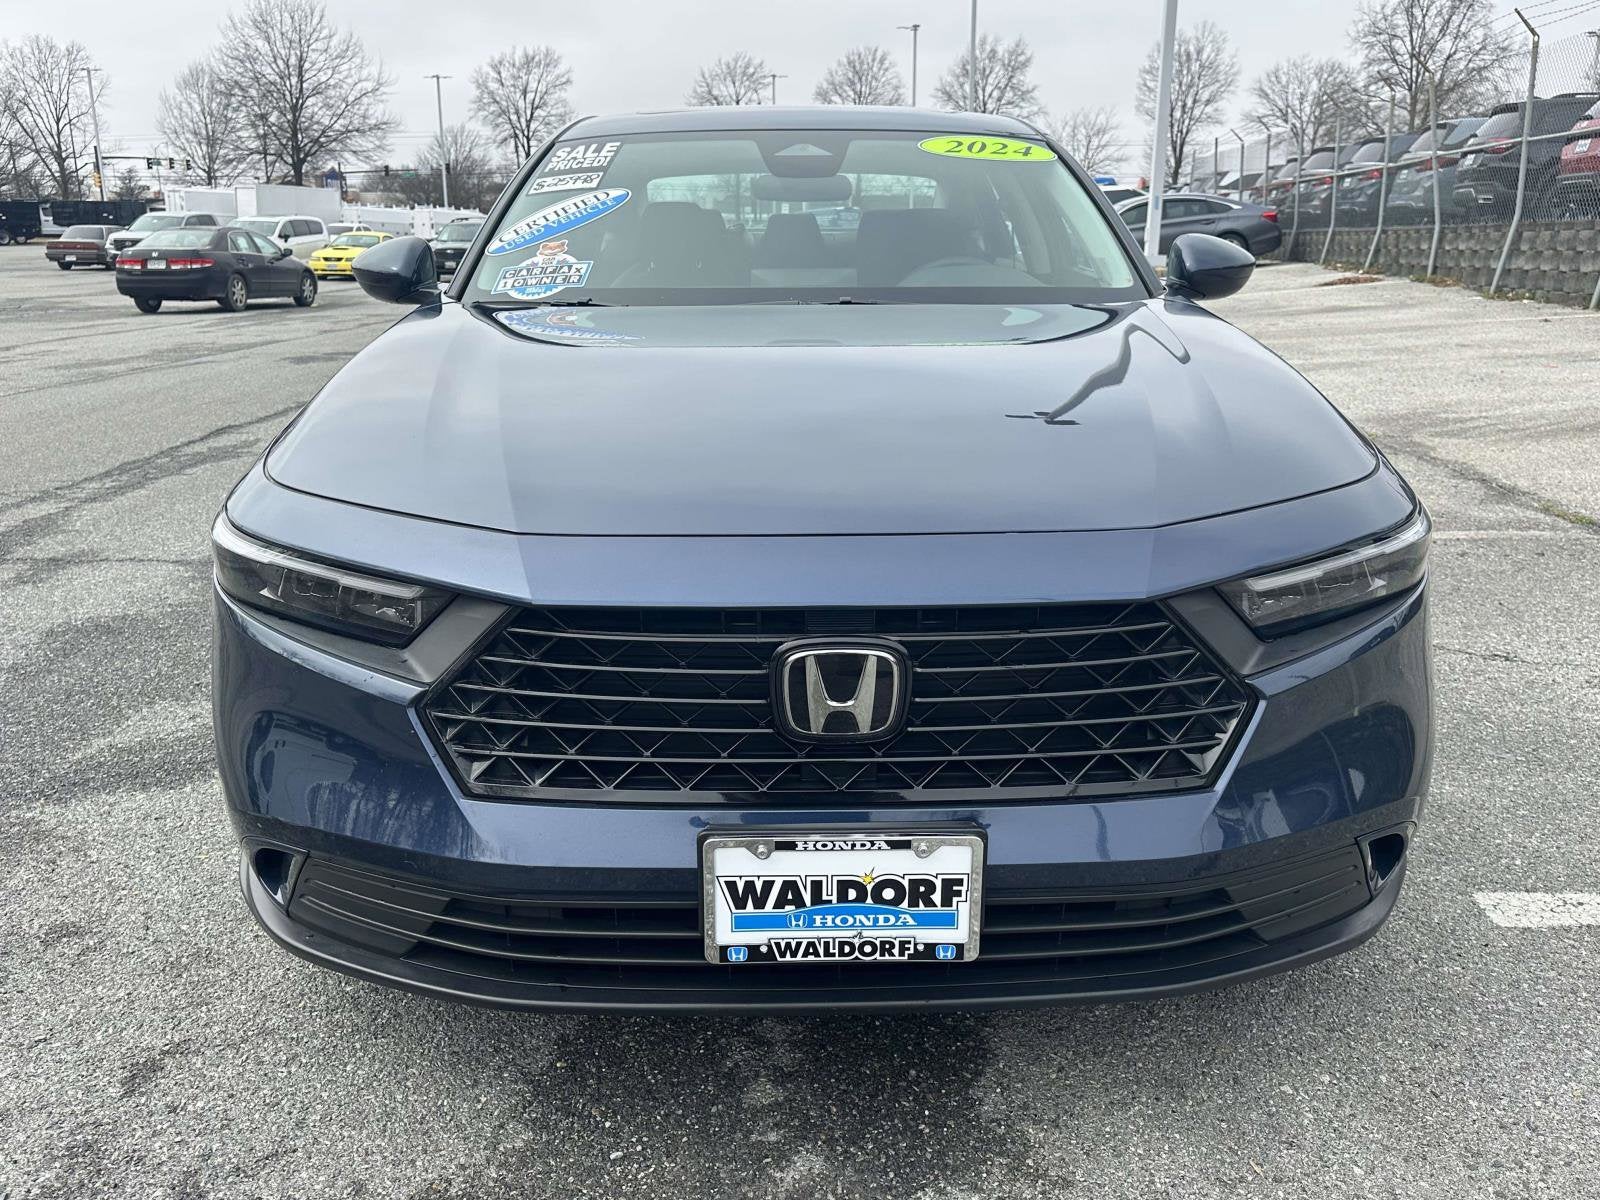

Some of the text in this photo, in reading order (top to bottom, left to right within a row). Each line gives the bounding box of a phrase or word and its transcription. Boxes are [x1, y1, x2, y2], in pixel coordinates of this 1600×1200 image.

[551, 142, 621, 162] SALE
[945, 140, 1032, 157] 2024
[544, 156, 612, 172] PRICED!
[500, 191, 610, 243] CERTIFIED
[503, 198, 616, 250] USED VEHICLE
[504, 265, 583, 278] CARFAX
[514, 275, 580, 286] OWNER
[795, 840, 891, 851] HONDA
[723, 878, 965, 910] WALDORF
[813, 914, 917, 927] HONDA
[773, 939, 913, 959] WALDORF
